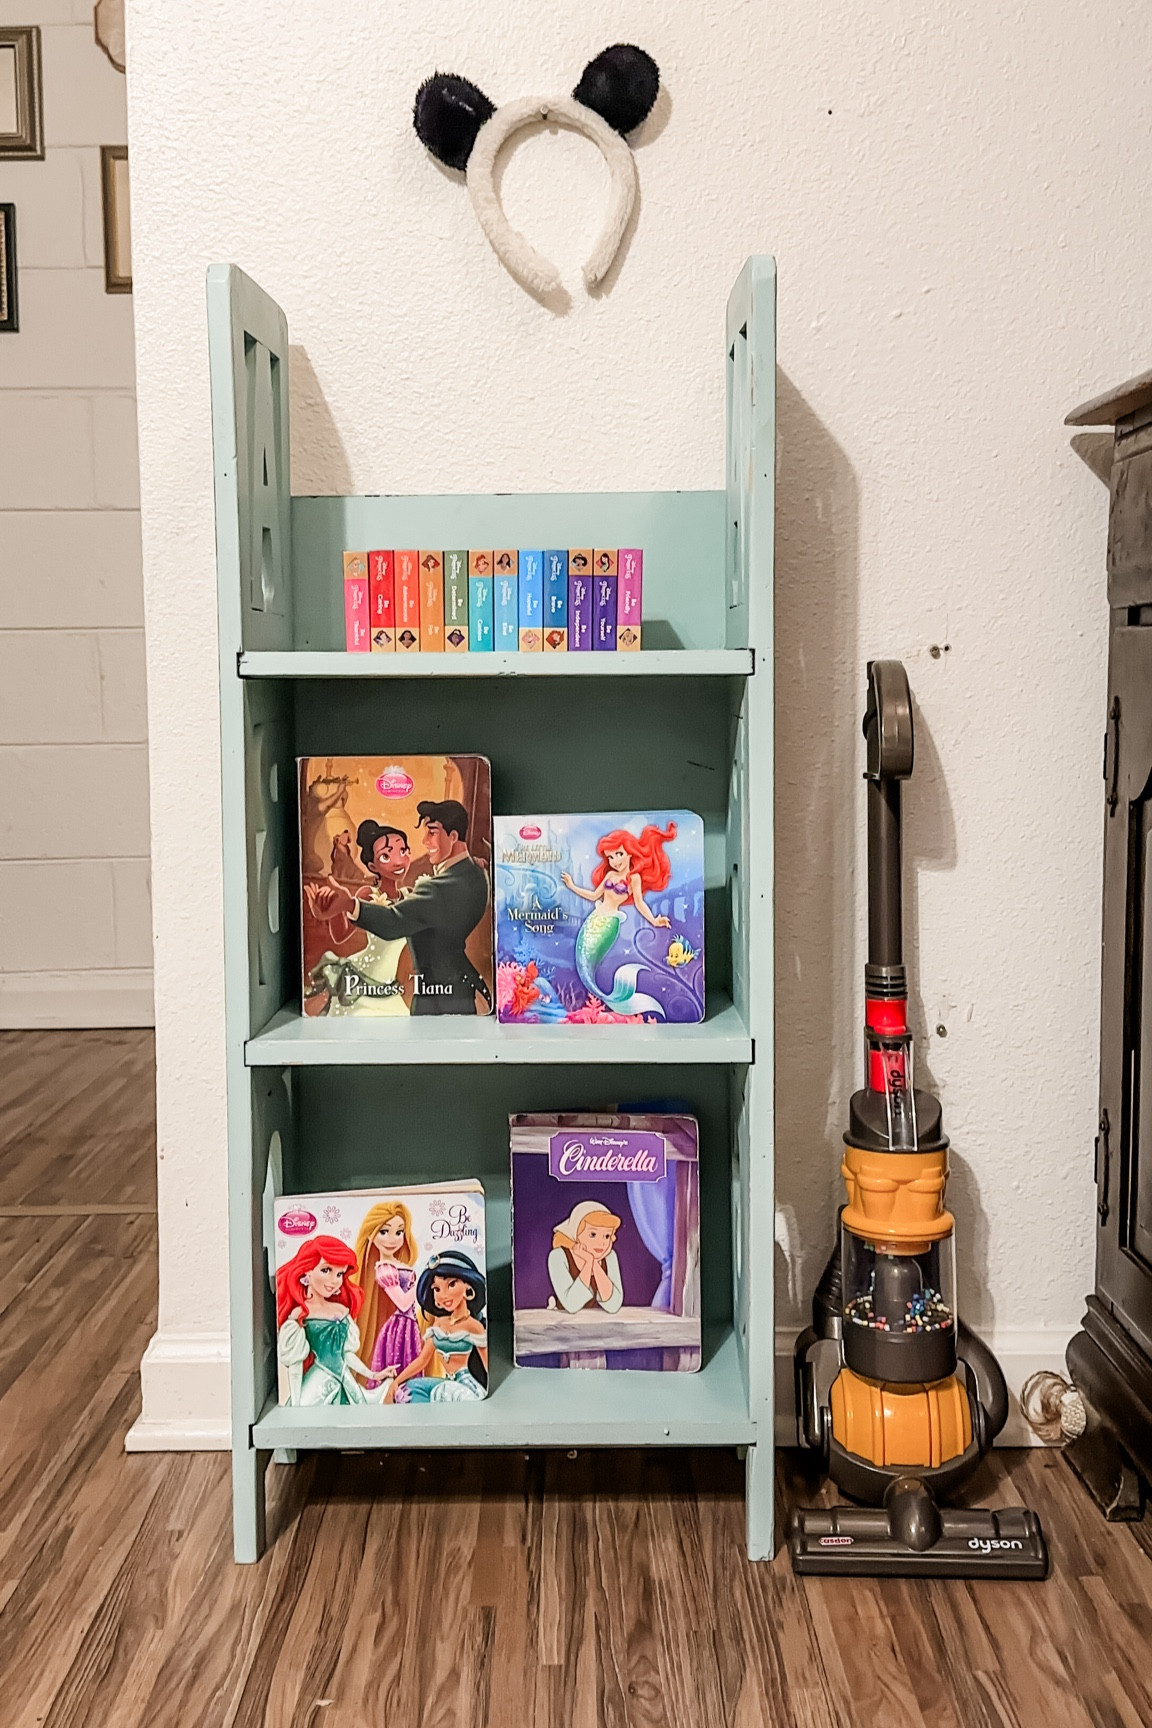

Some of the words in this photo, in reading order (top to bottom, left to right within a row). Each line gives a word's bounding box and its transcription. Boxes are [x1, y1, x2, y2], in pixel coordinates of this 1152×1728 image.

[378, 778, 412, 792] Disney
[531, 898, 542, 911] A
[507, 907, 568, 921] Mermaid's
[524, 920, 554, 934] Song
[344, 975, 404, 996] Princess
[409, 974, 453, 995] Tiana
[888, 1069, 905, 1116] dyson
[559, 1140, 658, 1176] Cinderella
[448, 1204, 471, 1226] Be
[280, 1216, 316, 1230] Disney
[431, 1219, 477, 1244] Dazzling
[968, 1538, 1022, 1553] dyson
